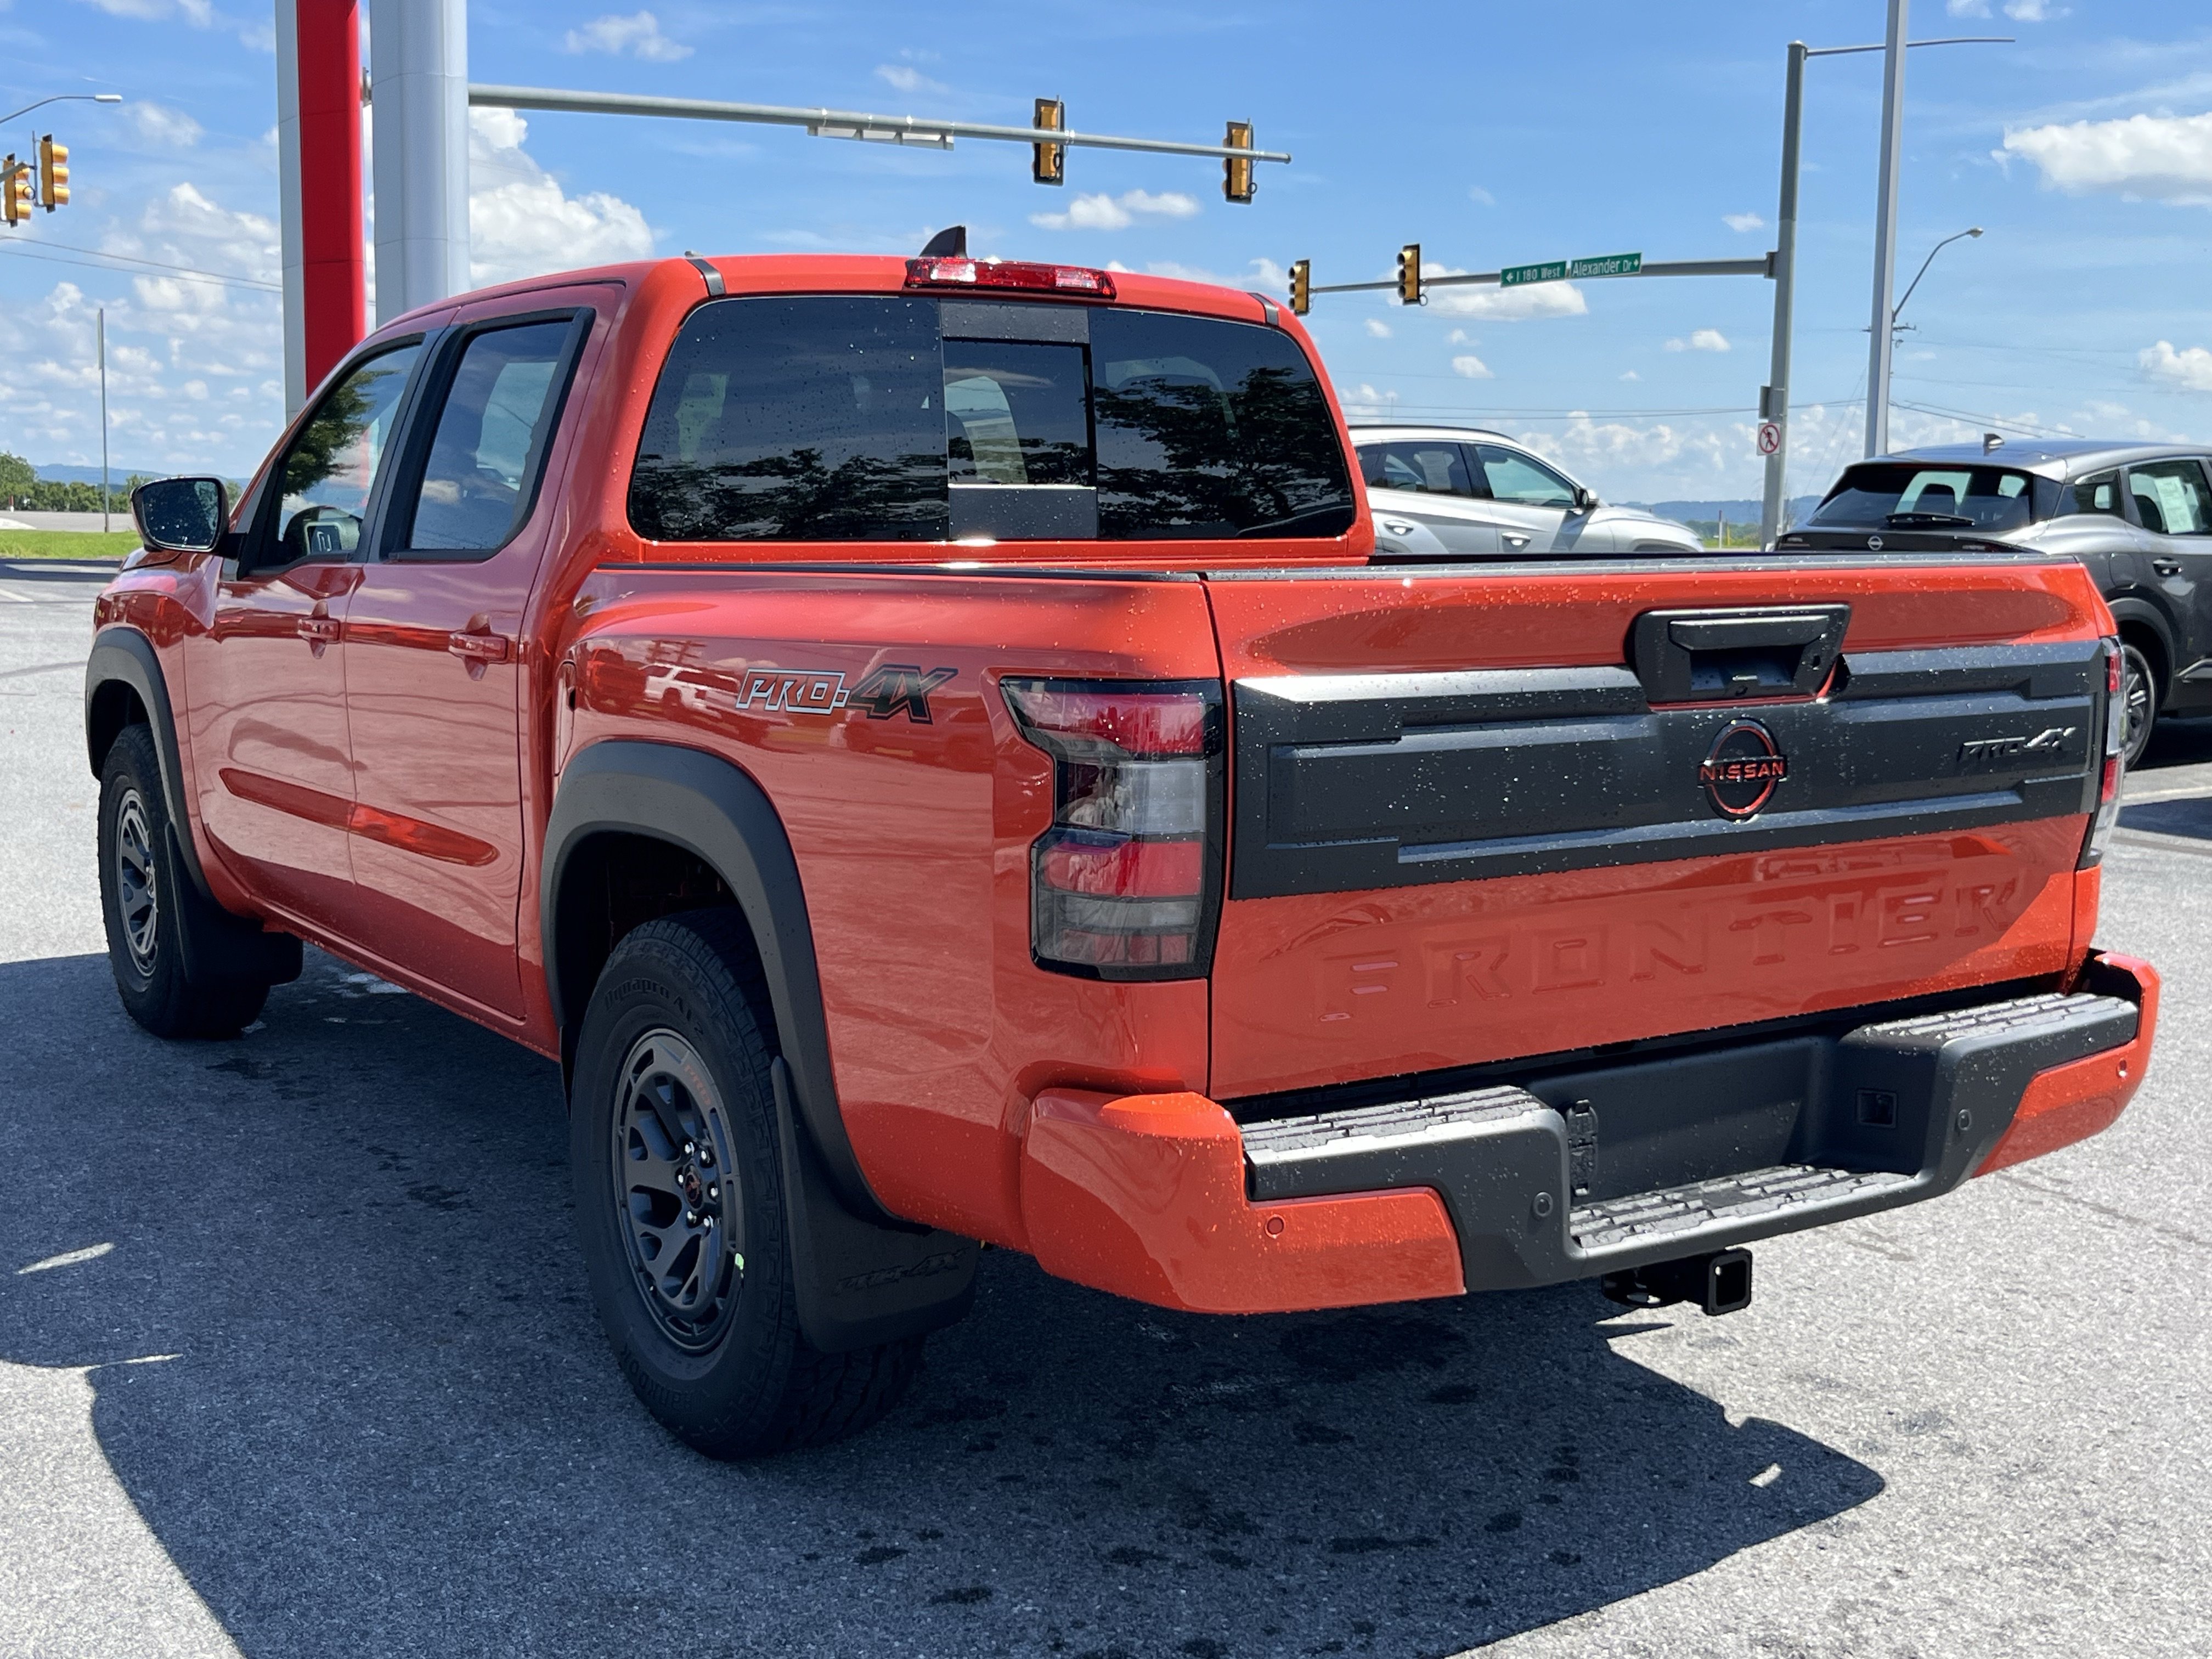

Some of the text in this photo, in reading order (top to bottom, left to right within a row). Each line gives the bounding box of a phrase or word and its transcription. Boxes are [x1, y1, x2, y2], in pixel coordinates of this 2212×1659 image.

[1523, 268, 1538, 281] 180
[1541, 266, 1561, 280] West
[1571, 258, 1632, 278] Alexander Dr
[1699, 759, 1786, 781] NISSAN
[1318, 876, 2022, 1023] FRONTIER
